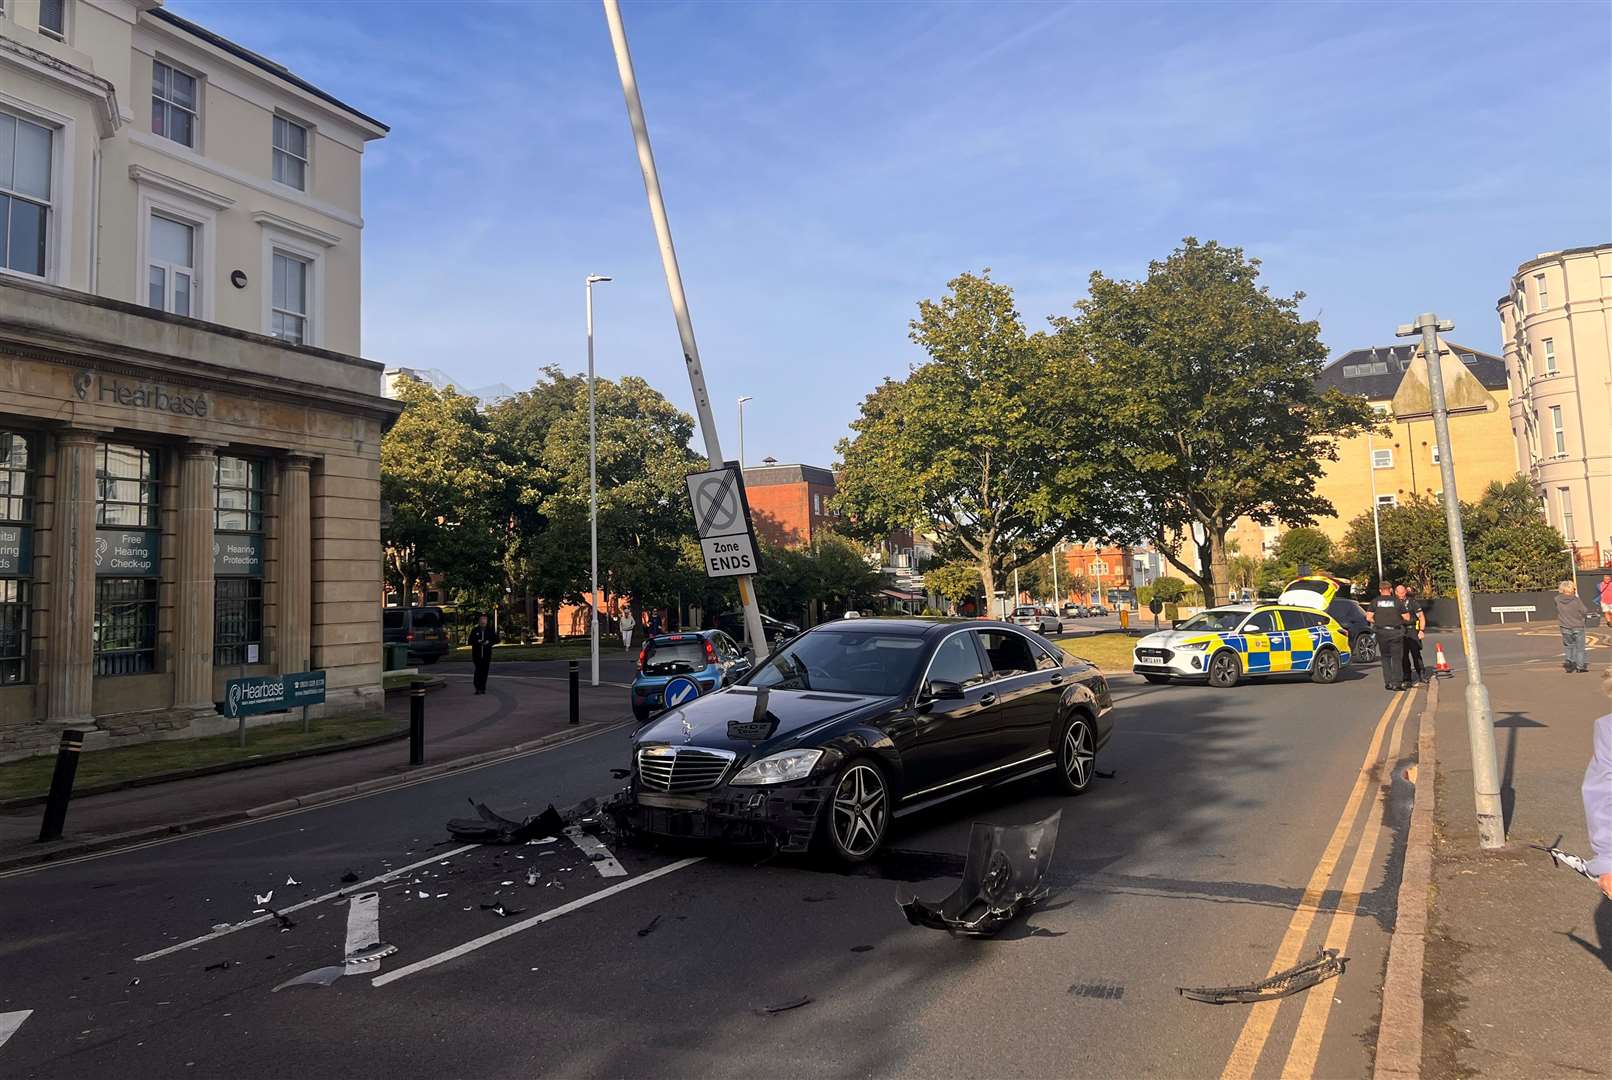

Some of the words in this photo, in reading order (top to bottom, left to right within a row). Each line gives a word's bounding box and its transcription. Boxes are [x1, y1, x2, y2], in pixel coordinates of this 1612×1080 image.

[97, 375, 209, 417] Hearbase
[1, 531, 16, 541] ital
[122, 534, 142, 544] Free
[0, 545, 19, 557] ring
[114, 546, 149, 558] Hearing
[227, 544, 255, 555] Hearing
[713, 542, 740, 553] Zone
[110, 558, 152, 570] Check-up
[223, 555, 259, 565] Protection
[710, 554, 751, 571] ENDS
[241, 681, 284, 700] Hearbase
